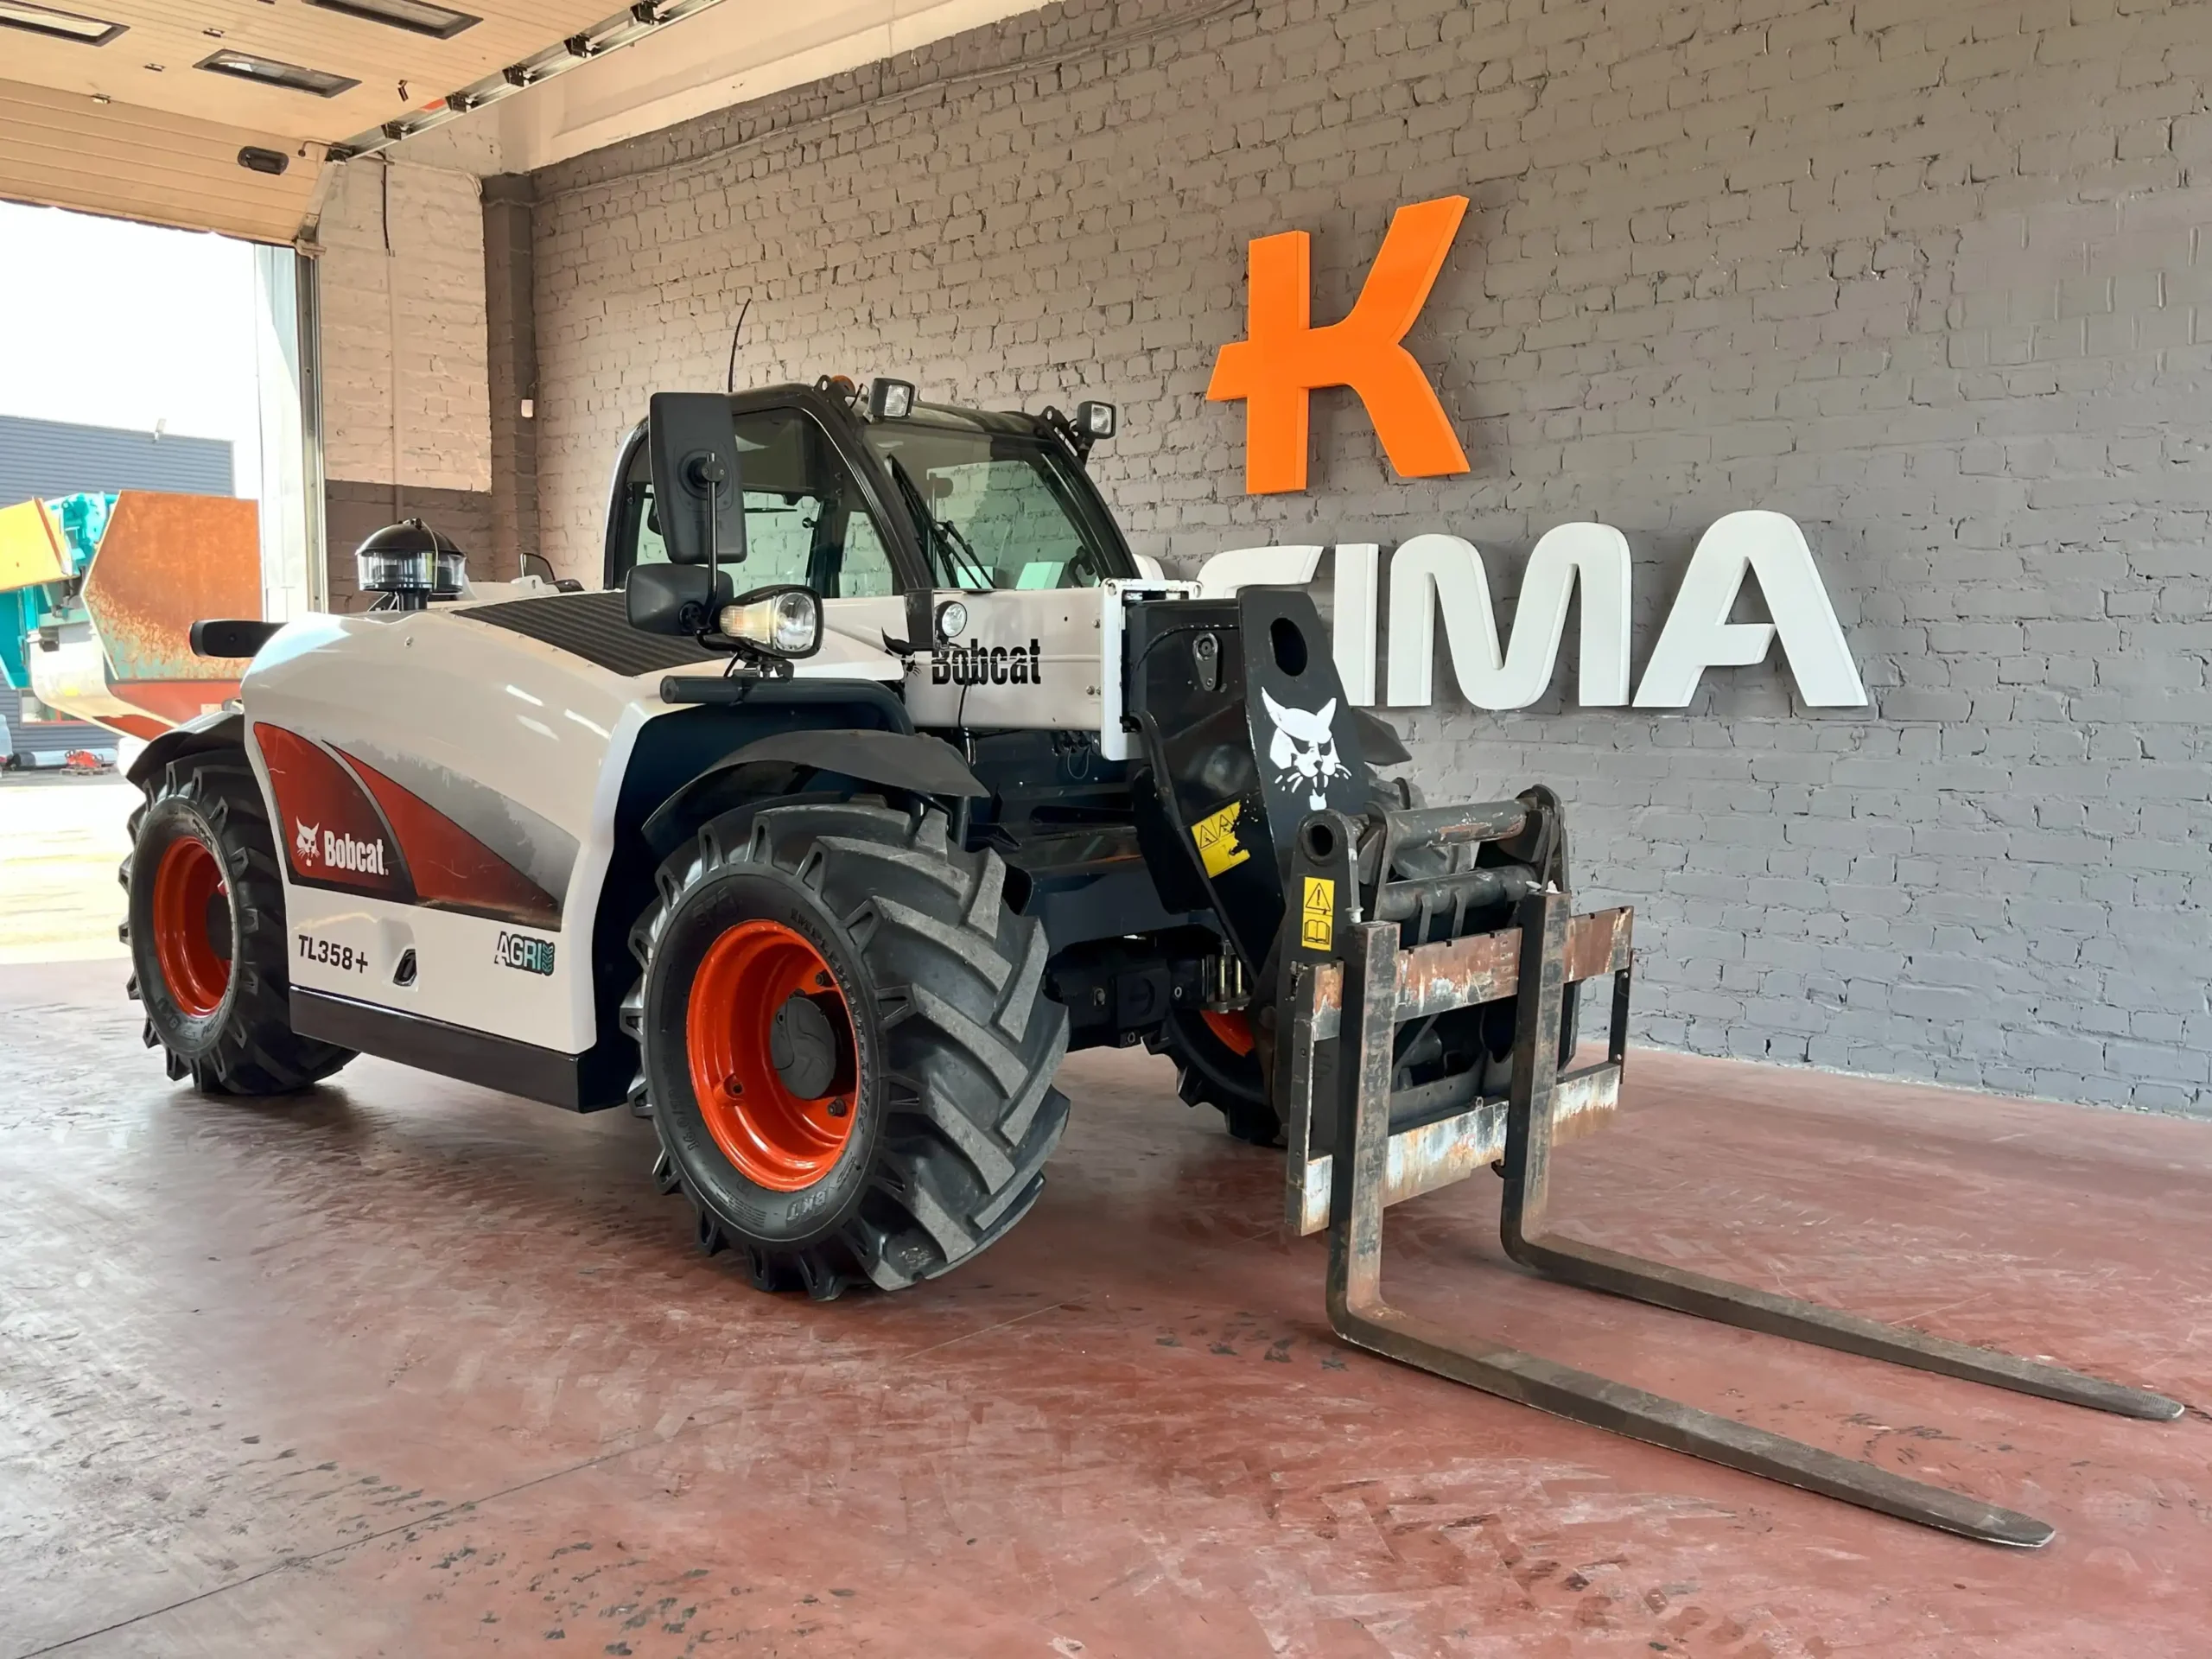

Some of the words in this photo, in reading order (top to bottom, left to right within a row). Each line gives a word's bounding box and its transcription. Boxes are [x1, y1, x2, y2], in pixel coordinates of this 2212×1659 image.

[932, 639, 1041, 685] Bobcat
[324, 830, 385, 875] Bobcat
[298, 934, 369, 974] TL358+
[494, 931, 543, 973] AGRI
